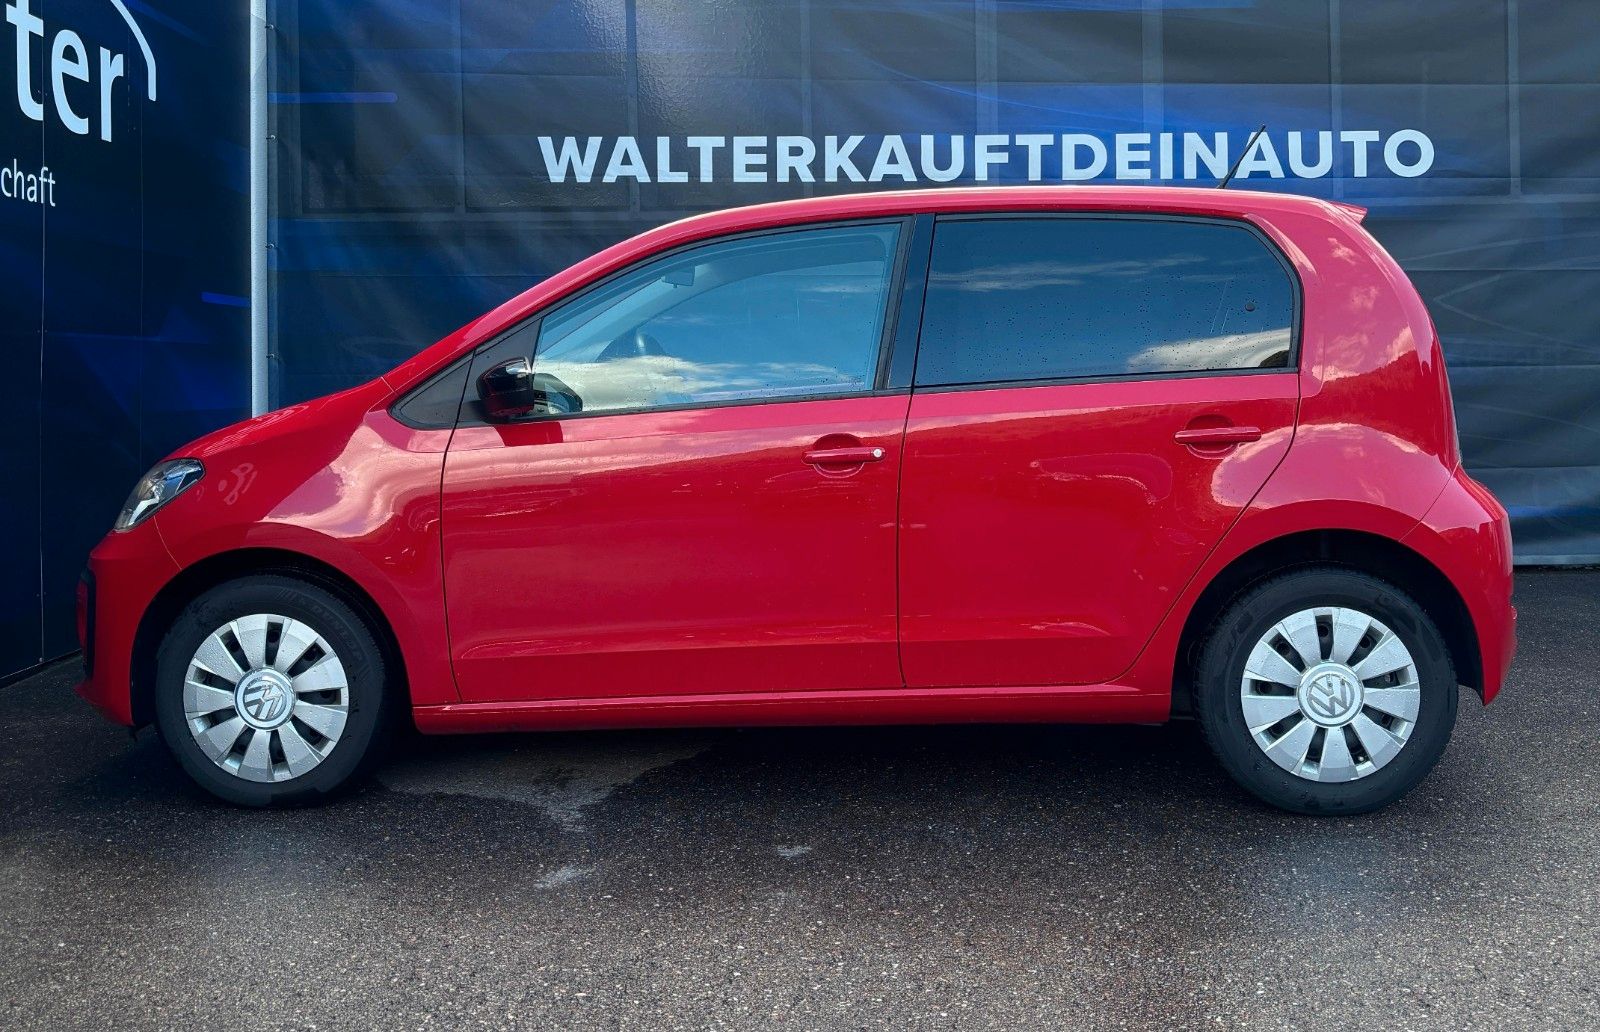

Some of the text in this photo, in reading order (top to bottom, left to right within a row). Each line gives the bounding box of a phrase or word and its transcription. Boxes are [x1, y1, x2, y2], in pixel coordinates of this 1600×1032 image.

[6, 0, 124, 142] ter
[0, 158, 56, 207] chaft
[537, 129, 1435, 183] WALTERKAUFTDEINAUTO
